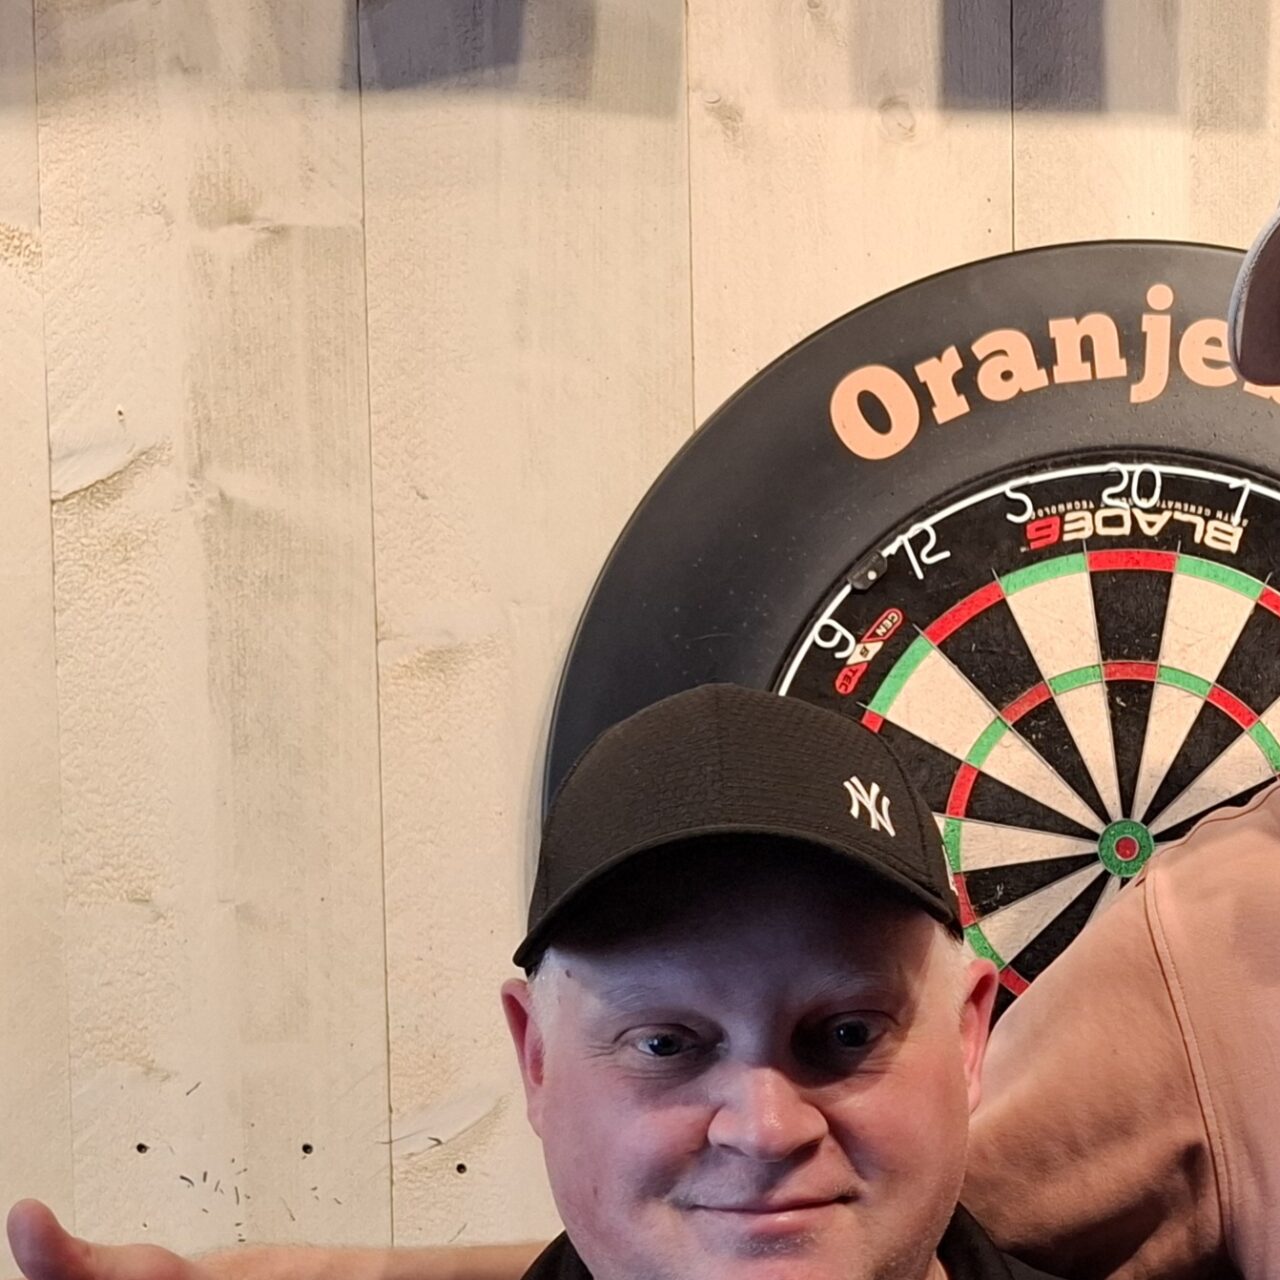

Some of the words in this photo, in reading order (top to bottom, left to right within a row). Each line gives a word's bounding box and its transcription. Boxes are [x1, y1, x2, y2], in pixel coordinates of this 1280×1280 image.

[1005, 478, 1034, 524] 5
[1101, 462, 1162, 509] 20
[1229, 479, 1251, 528] 1
[890, 522, 951, 580] 12
[814, 618, 857, 659] 9
[875, 612, 898, 637] GEN
[838, 667, 859, 693] TEC
[843, 775, 896, 837] NY
